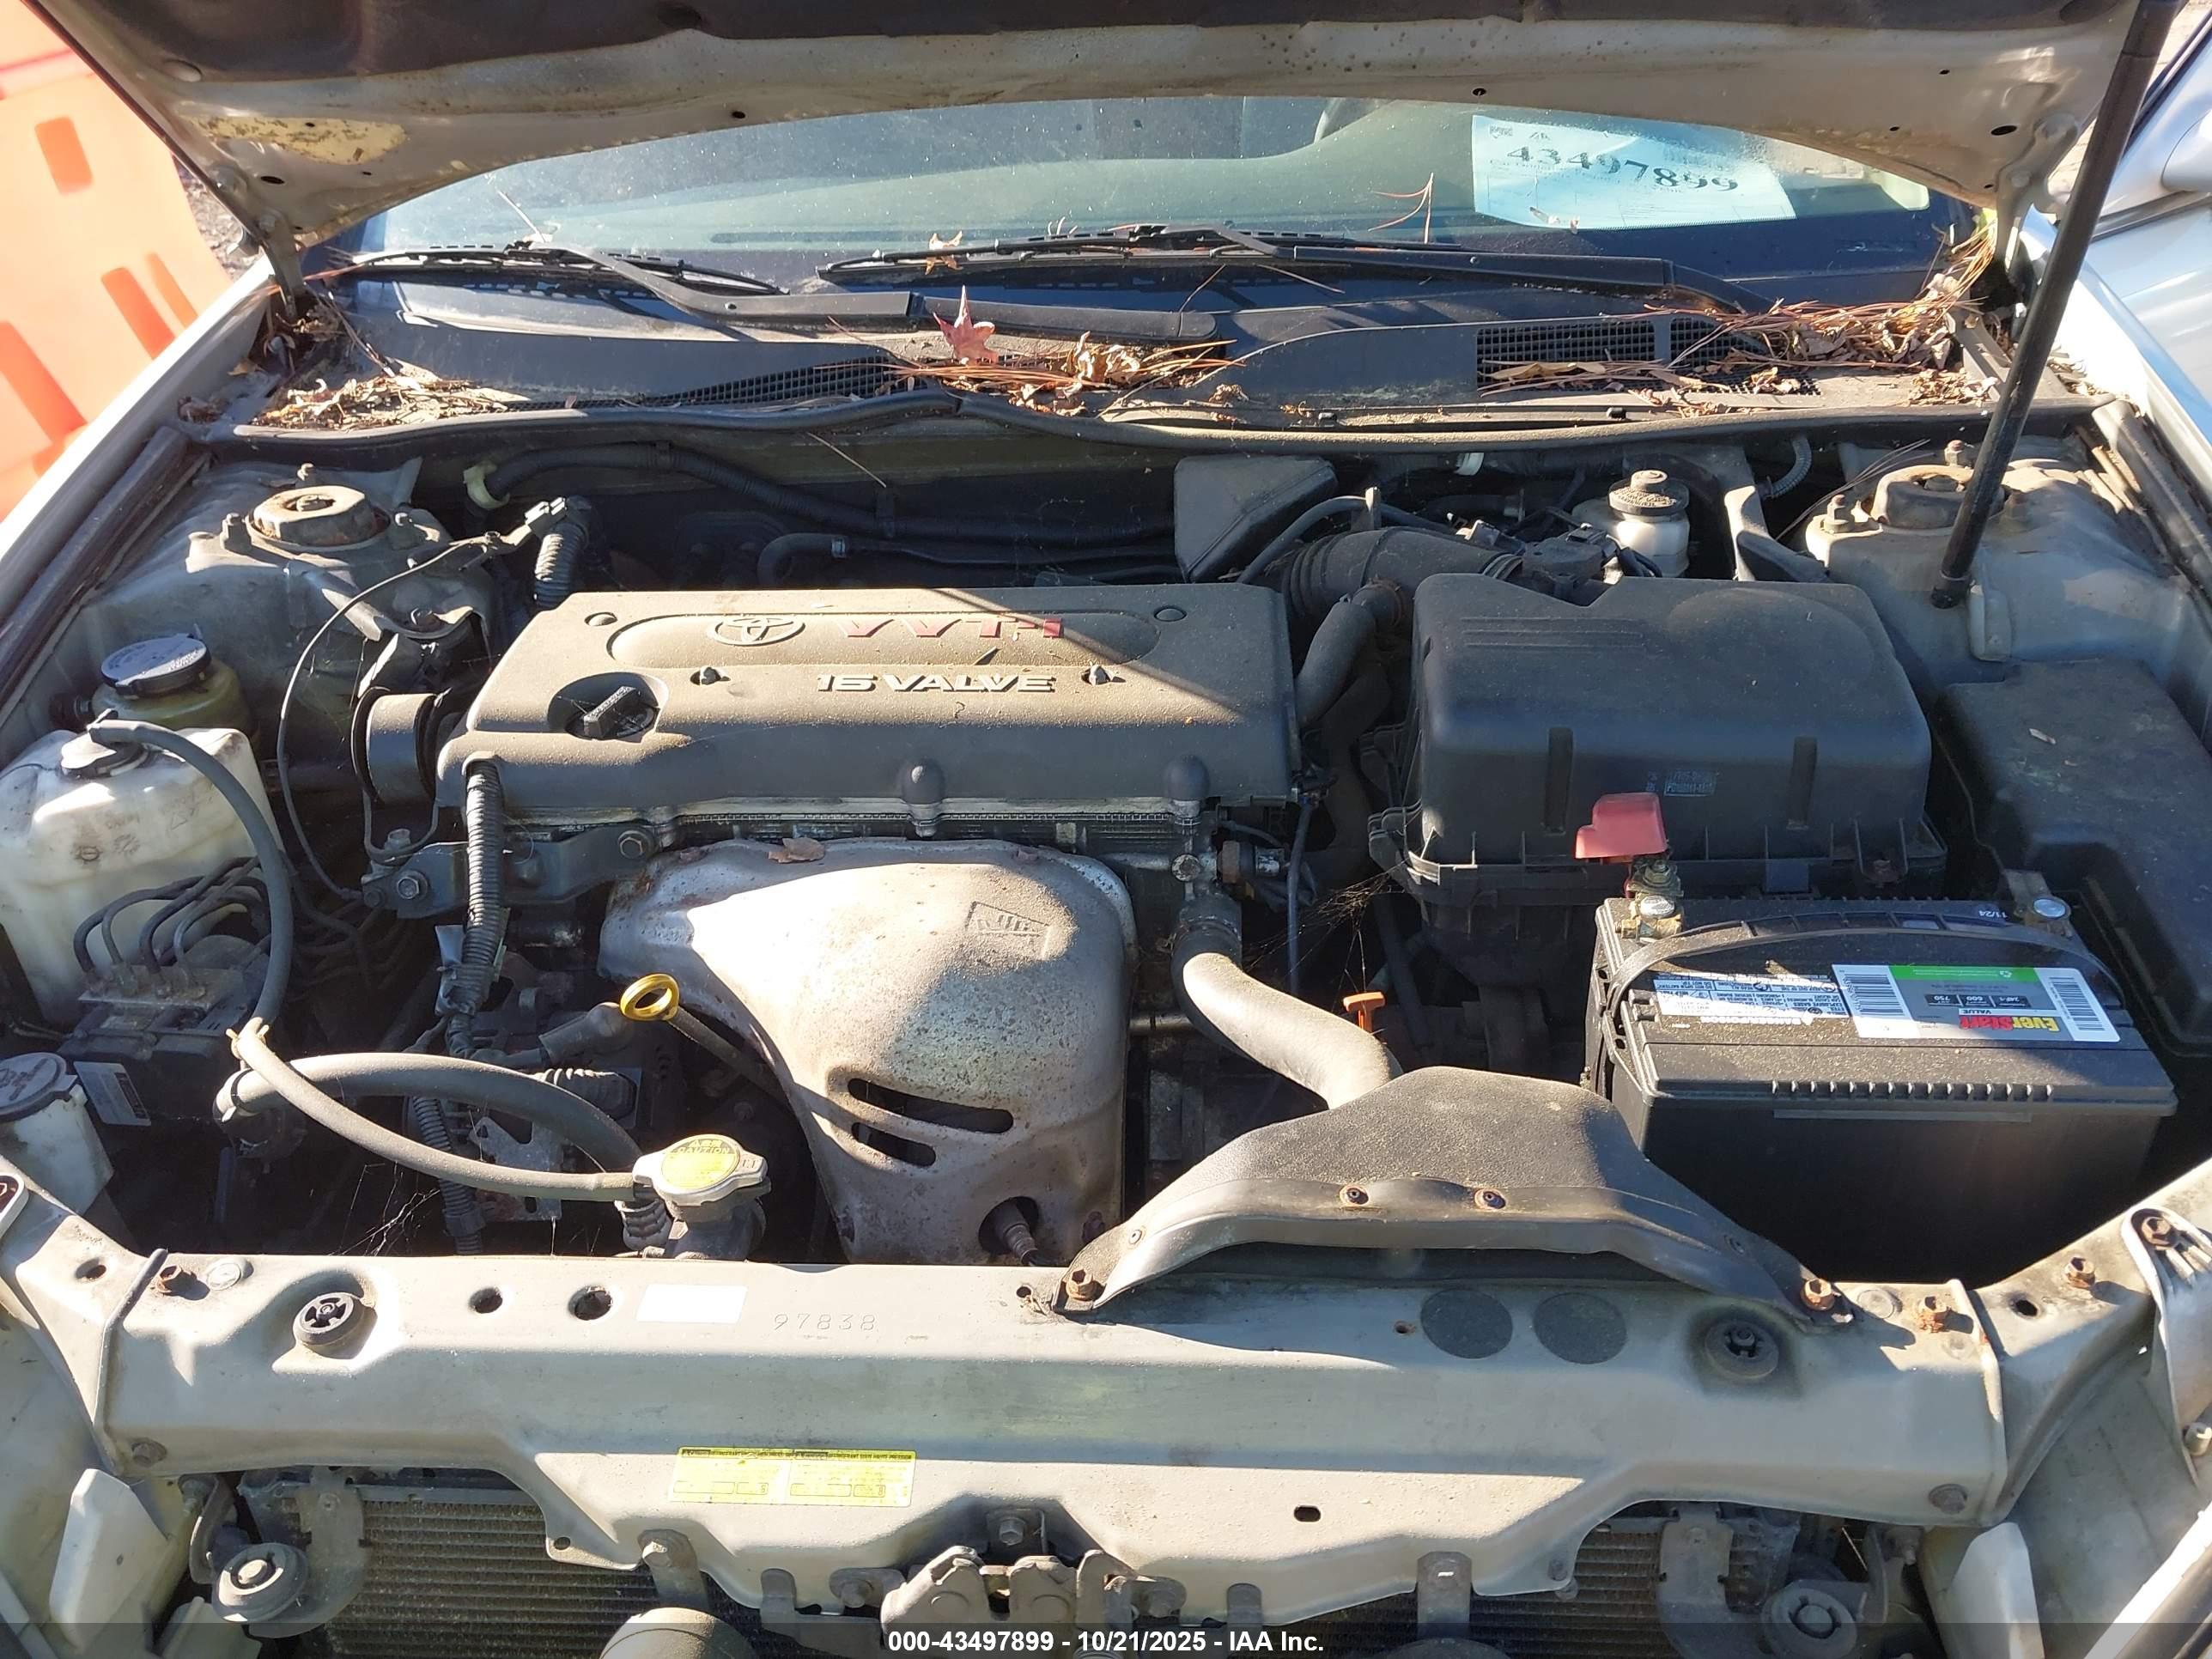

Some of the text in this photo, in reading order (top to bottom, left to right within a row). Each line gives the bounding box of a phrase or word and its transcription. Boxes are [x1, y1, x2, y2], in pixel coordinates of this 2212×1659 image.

[1506, 145, 1739, 191] 43497899
[817, 673, 1057, 693] 16 VALVE
[1960, 1017, 2060, 1032] EverStart
[677, 1146, 730, 1155] CAUTION
[774, 1312, 877, 1332] 97838
